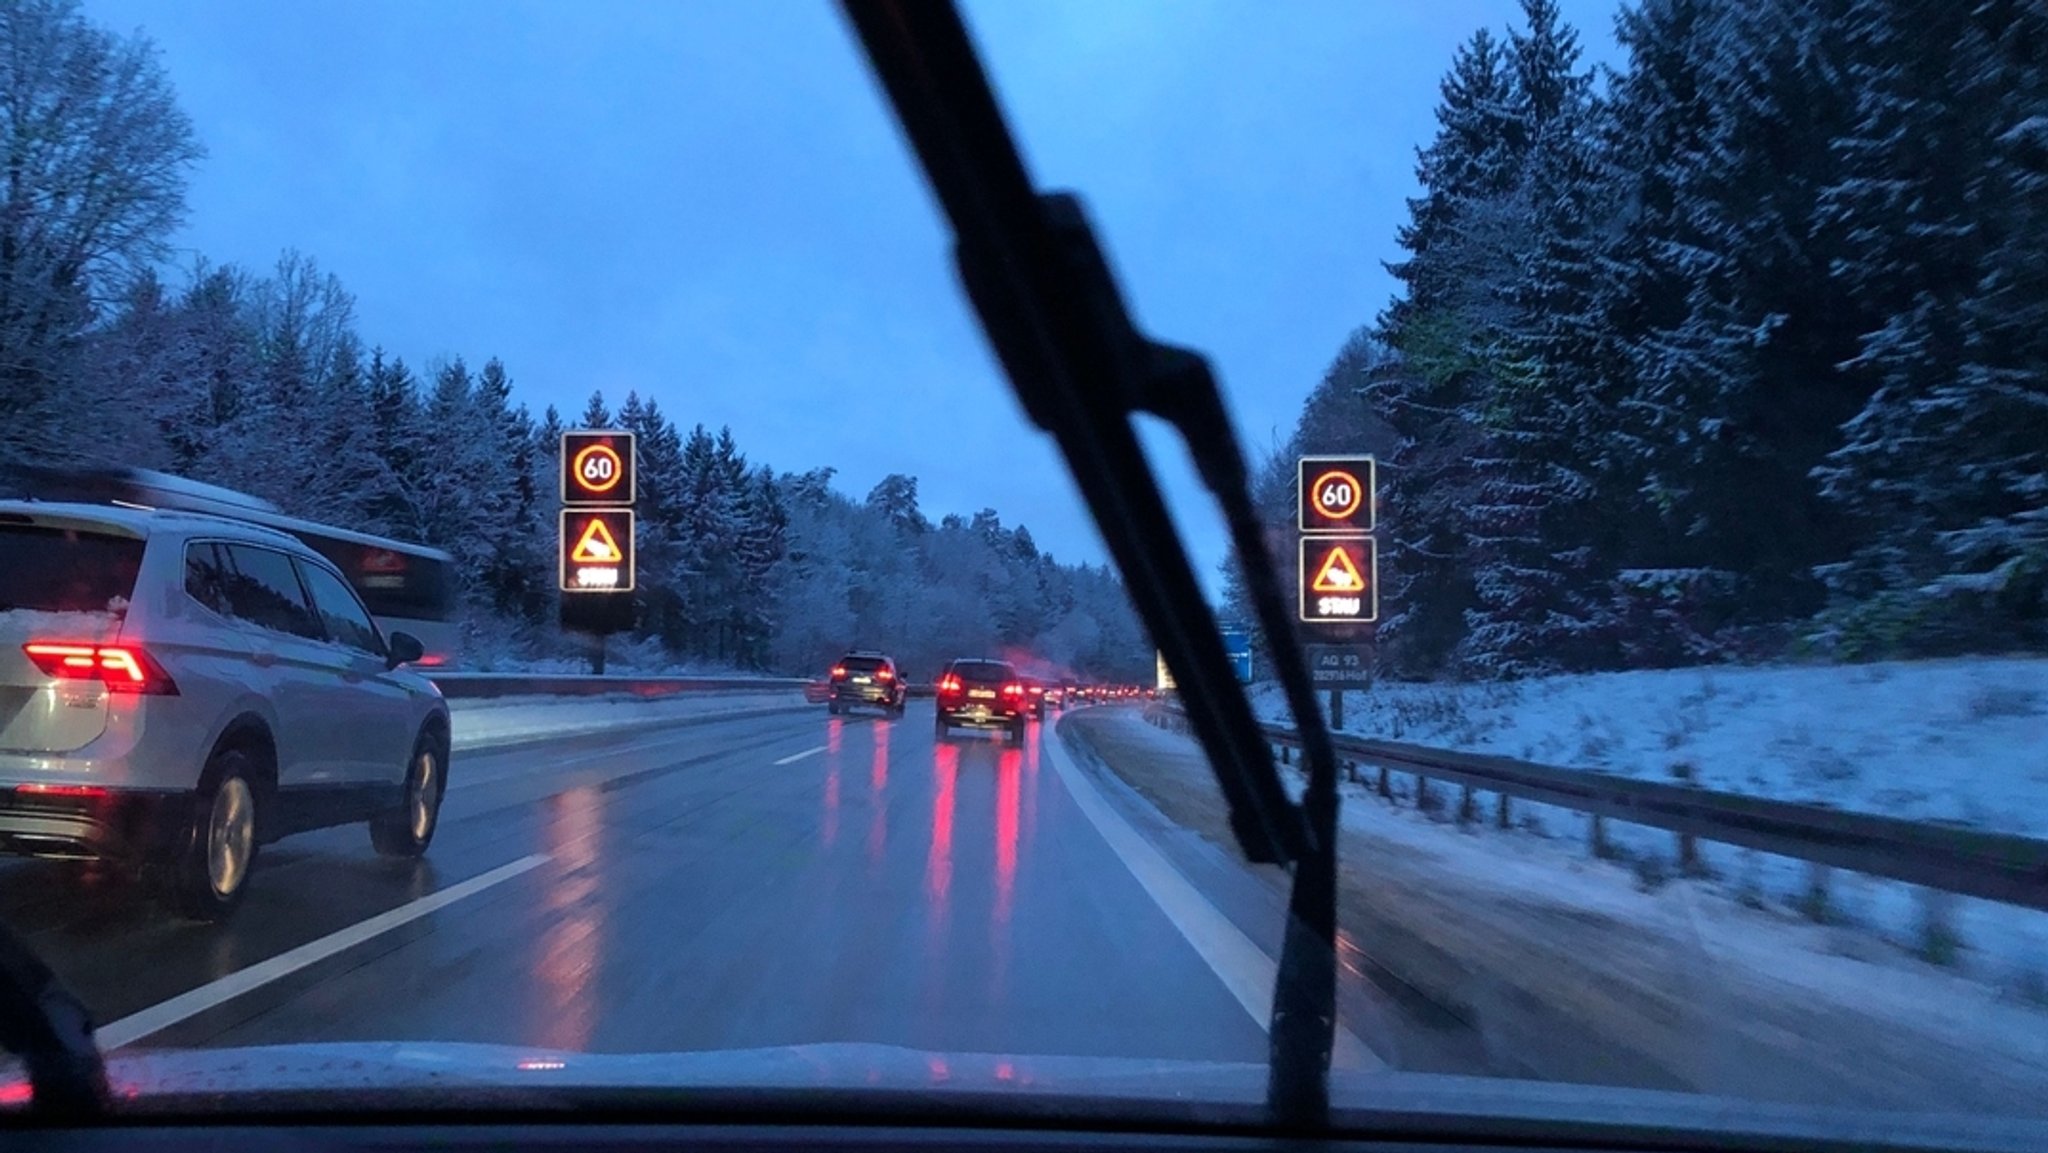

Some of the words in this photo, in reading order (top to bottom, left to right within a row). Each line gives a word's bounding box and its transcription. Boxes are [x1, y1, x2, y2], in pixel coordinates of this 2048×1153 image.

[584, 457, 612, 479] 60
[1322, 483, 1351, 506] 60
[1343, 654, 1360, 666] 93
